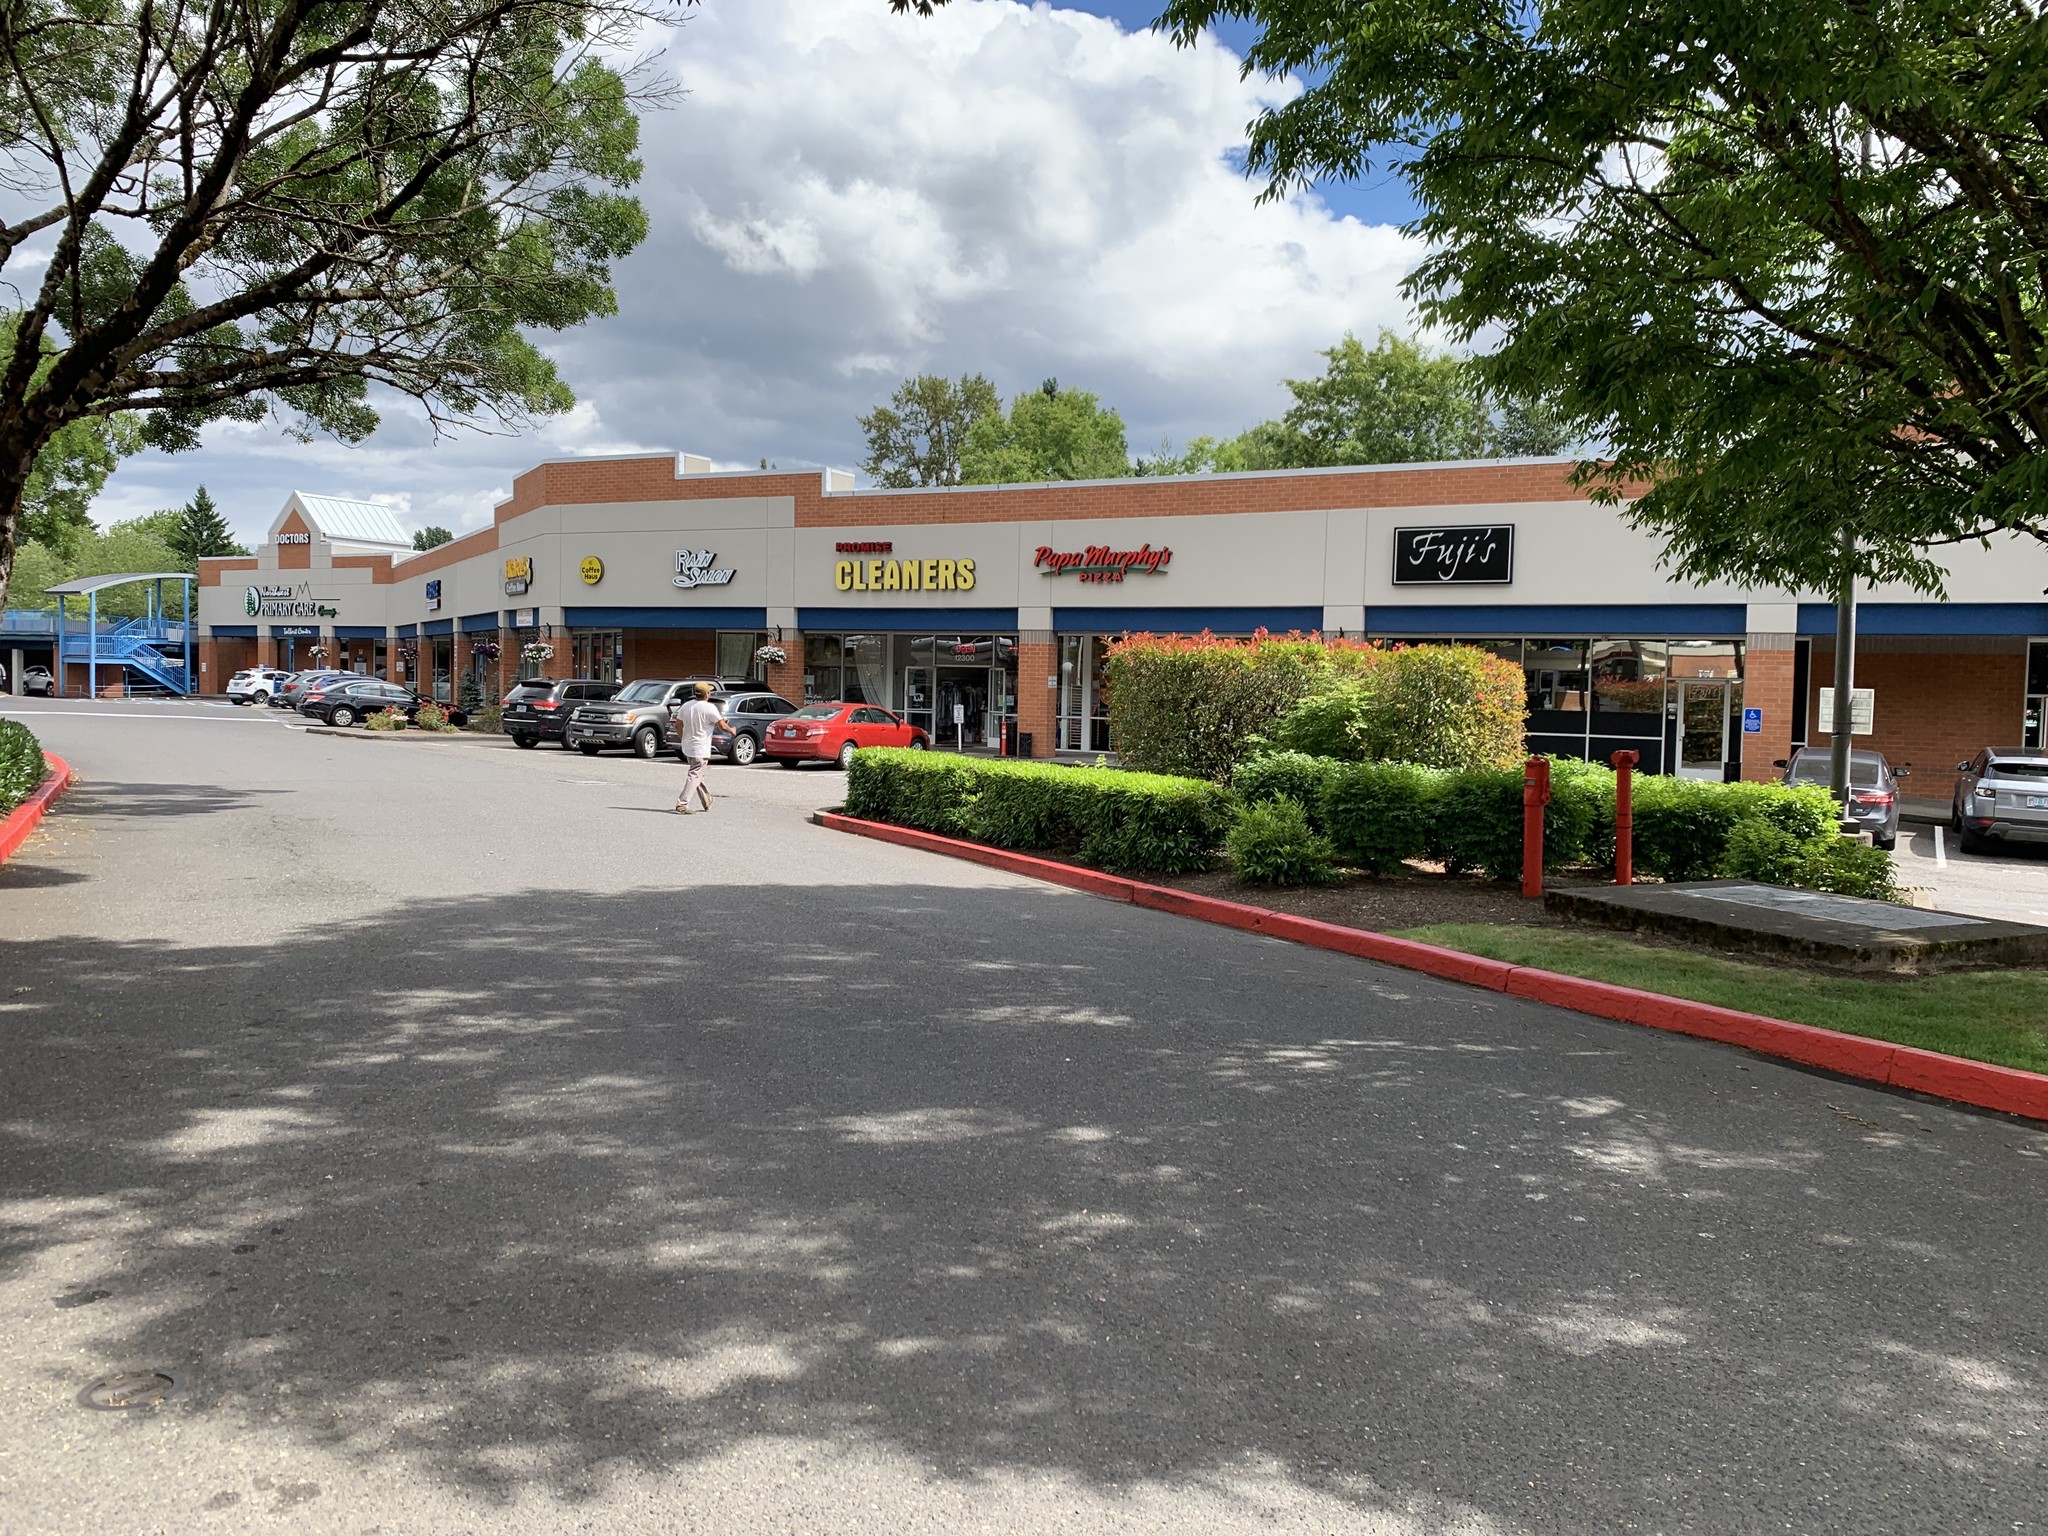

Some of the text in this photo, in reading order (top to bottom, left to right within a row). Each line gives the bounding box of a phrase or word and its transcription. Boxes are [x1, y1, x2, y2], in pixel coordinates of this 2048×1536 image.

[275, 533, 310, 544] DOCTORS
[836, 542, 893, 554] PROMISE
[1408, 527, 1498, 581] Fuji's
[1034, 543, 1173, 575] Papa Murphy's
[835, 558, 977, 592] CLEANERS
[1079, 572, 1124, 583] PIZZA
[261, 603, 292, 616] PRIMARY
[294, 603, 316, 616] CARE
[955, 645, 976, 653] OPEN
